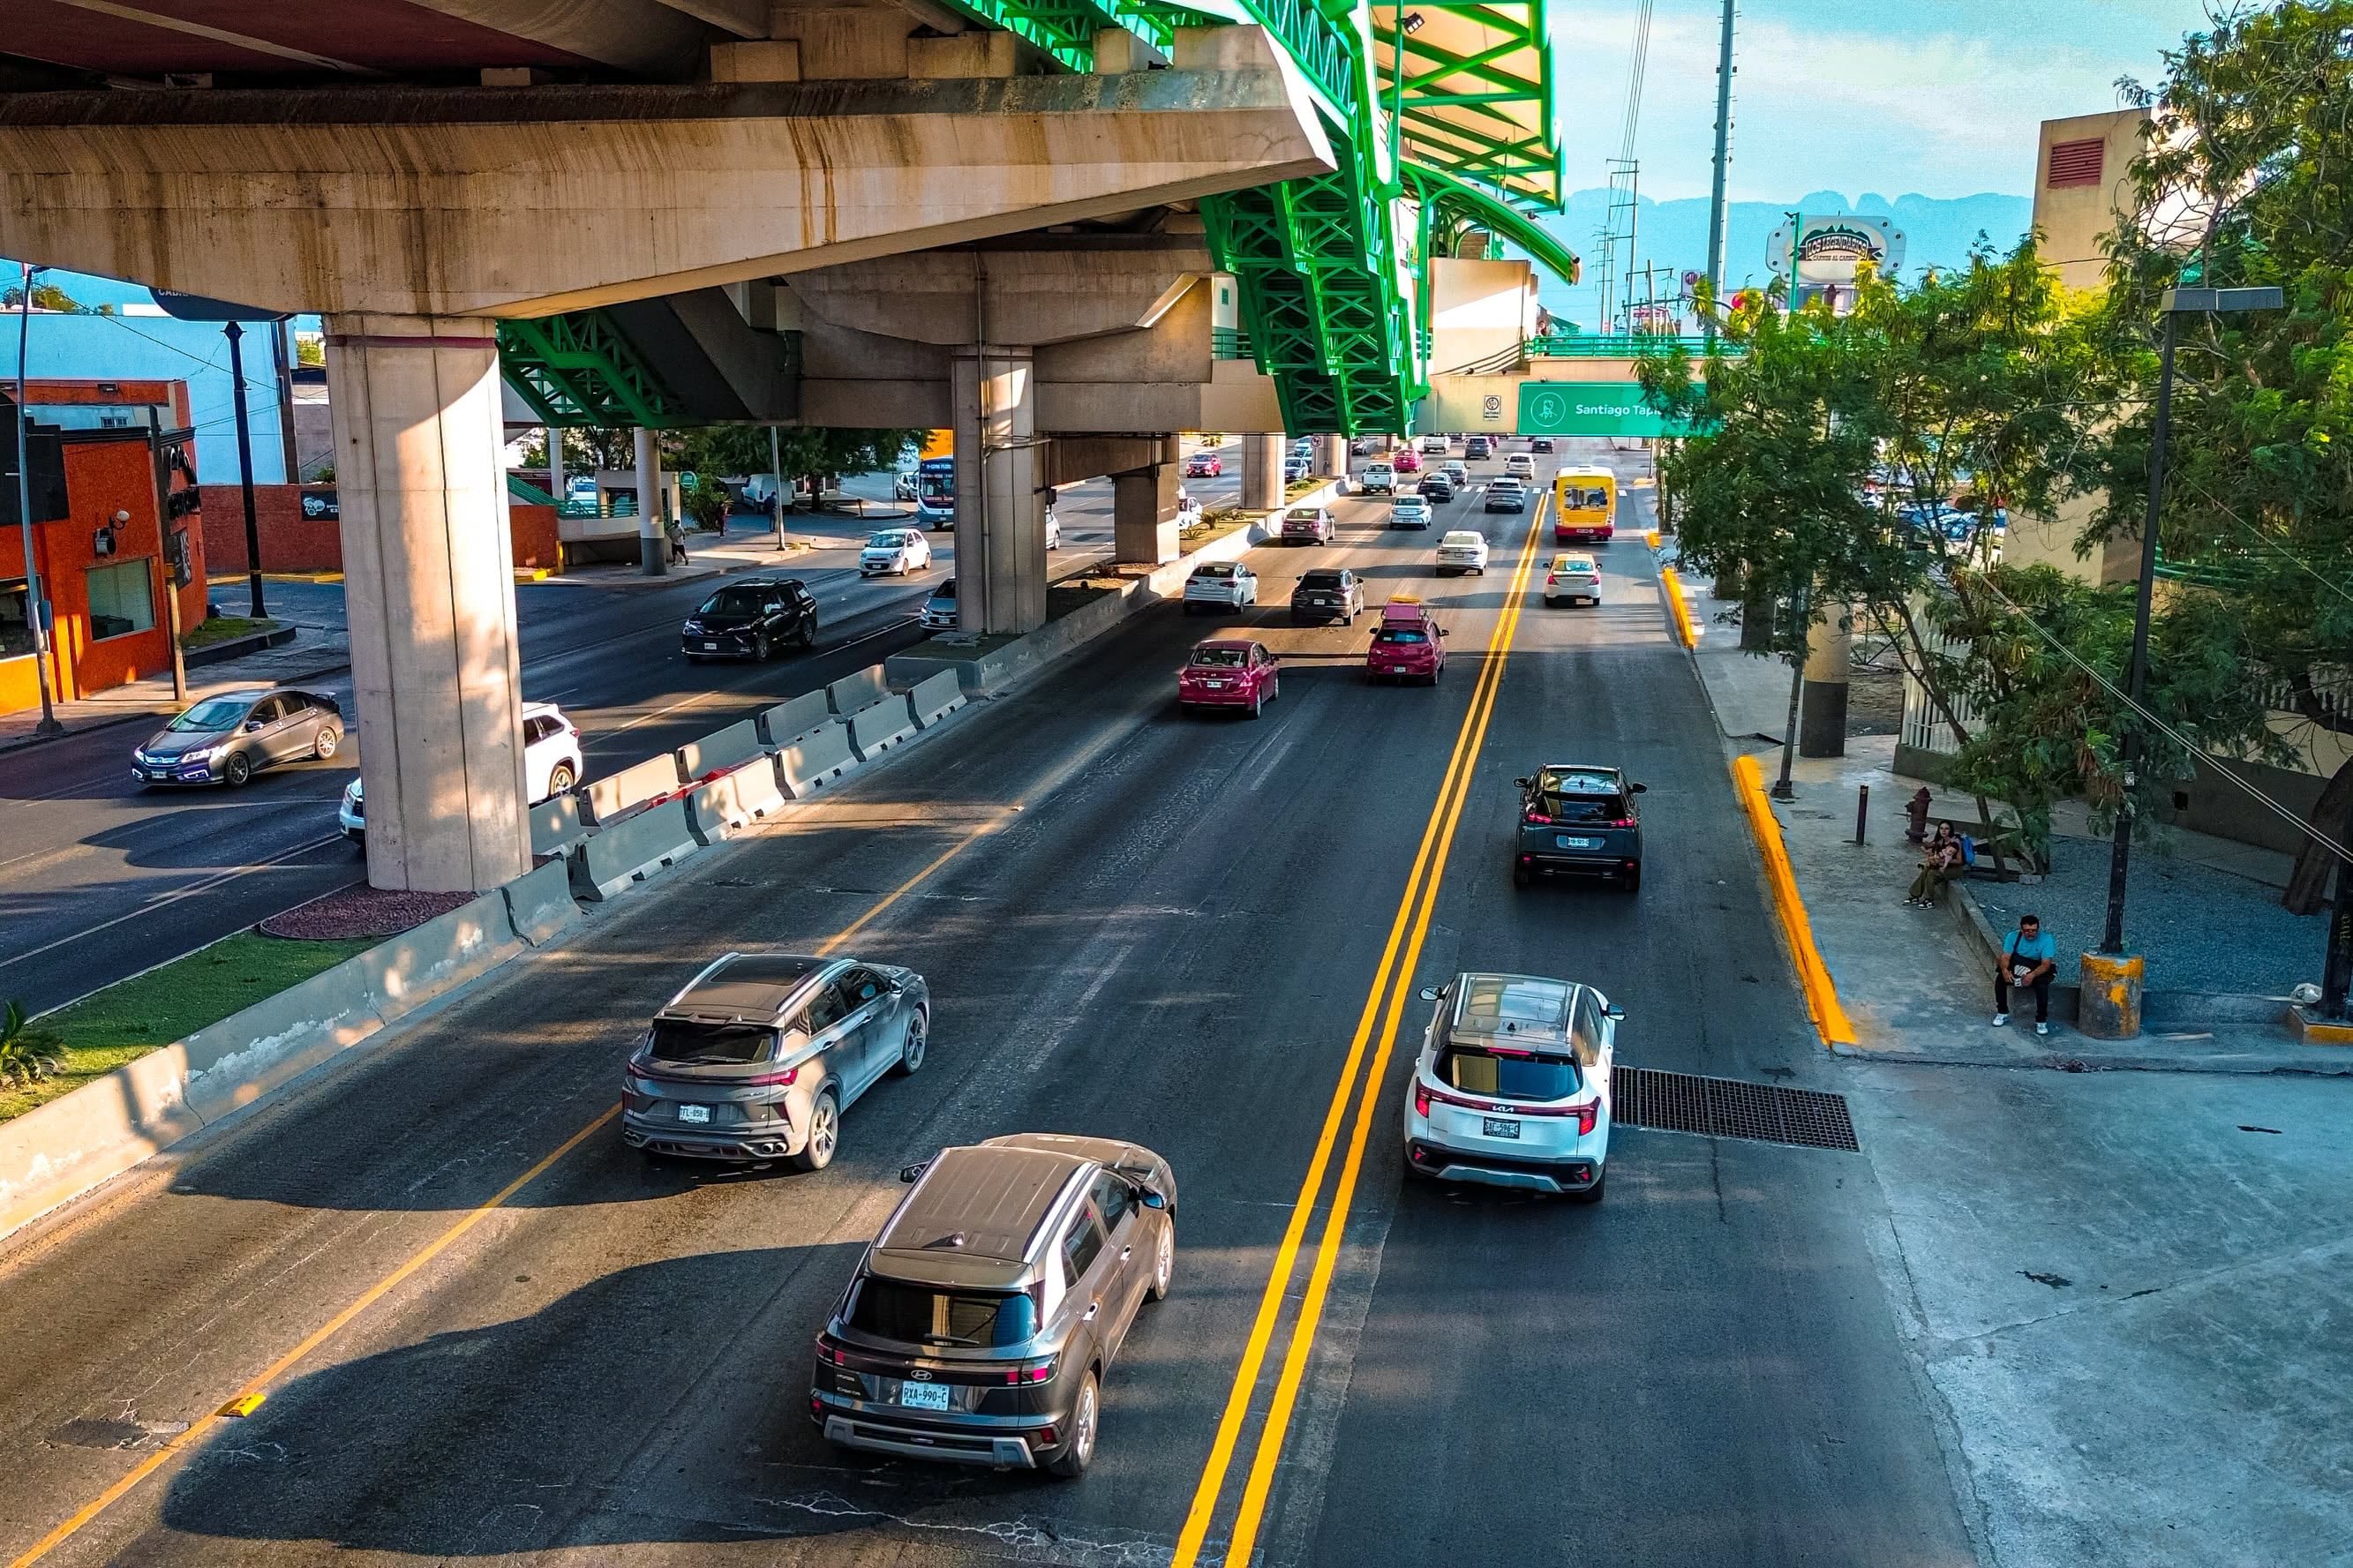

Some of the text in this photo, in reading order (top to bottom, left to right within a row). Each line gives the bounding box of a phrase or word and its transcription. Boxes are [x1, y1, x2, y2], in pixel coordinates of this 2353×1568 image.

[1808, 235, 1868, 257] LOS LEGENDARIOS
[1575, 404, 1630, 417] Santiago
[904, 1387, 947, 1403] RXA-990-C
